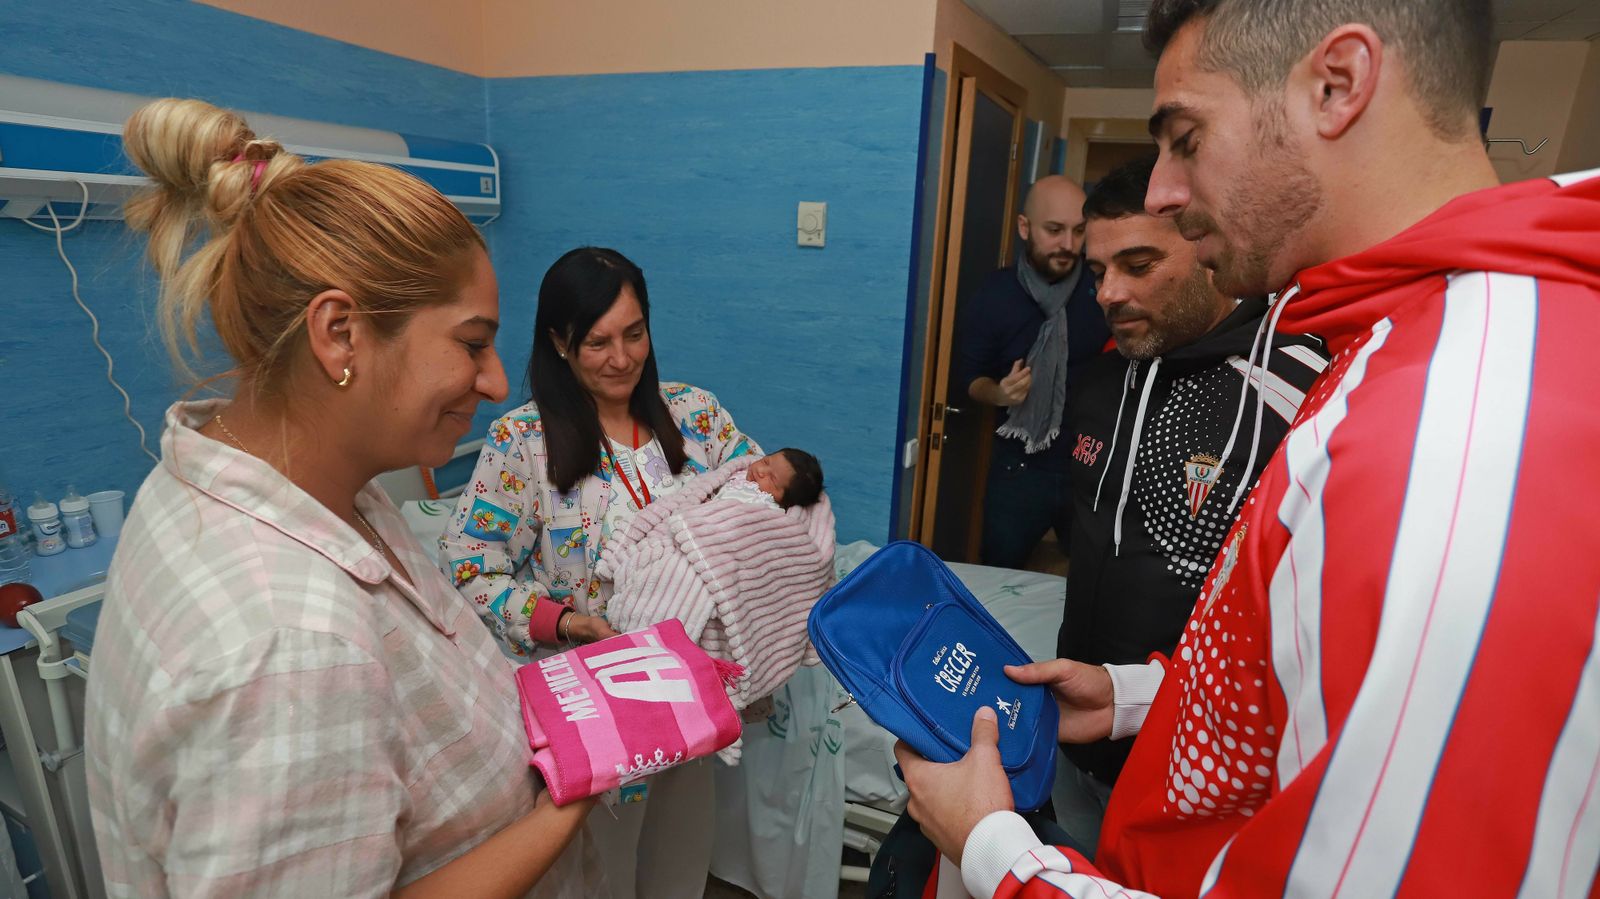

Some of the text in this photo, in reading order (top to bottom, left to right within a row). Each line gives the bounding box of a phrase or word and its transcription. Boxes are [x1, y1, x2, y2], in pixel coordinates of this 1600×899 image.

[484, 179, 490, 192] 1
[584, 634, 695, 703] AL
[934, 642, 977, 693] CRECER
